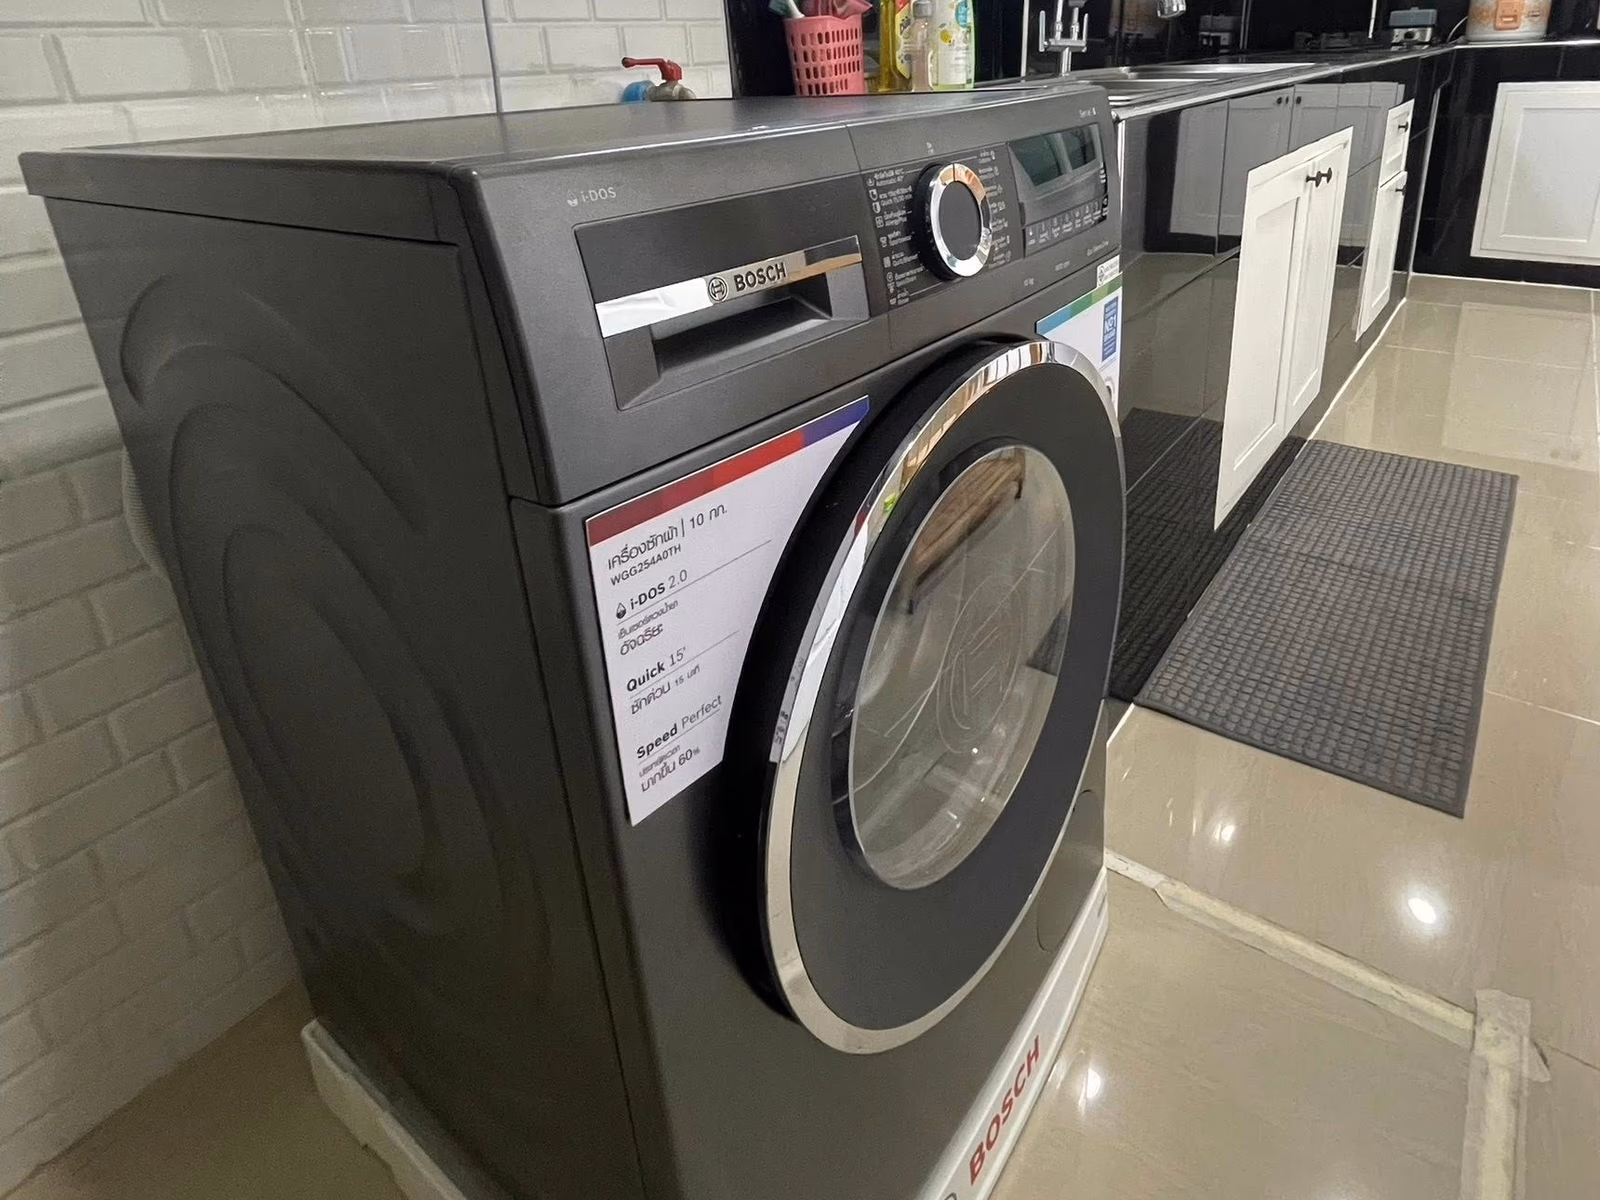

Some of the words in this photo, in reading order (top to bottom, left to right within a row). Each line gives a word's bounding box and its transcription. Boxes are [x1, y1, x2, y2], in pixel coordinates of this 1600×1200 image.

[580, 186, 617, 202] i-DOS
[733, 262, 786, 292] BOSCH
[607, 526, 679, 570] เครื่องซักผ้า
[690, 513, 704, 529] 10
[709, 504, 727, 521] กก.
[610, 543, 682, 586] WGG254A0TH
[630, 582, 665, 610] i-DOS
[668, 569, 688, 589] 2.0
[620, 624, 663, 655] อัจฉริยะ
[626, 661, 665, 692] Quick
[631, 681, 671, 715] ซักด่วน
[636, 723, 678, 759] Speed
[681, 695, 722, 729] Perfect
[641, 761, 676, 792] มากขึ้น
[969, 1034, 1040, 1186] BOSCH
